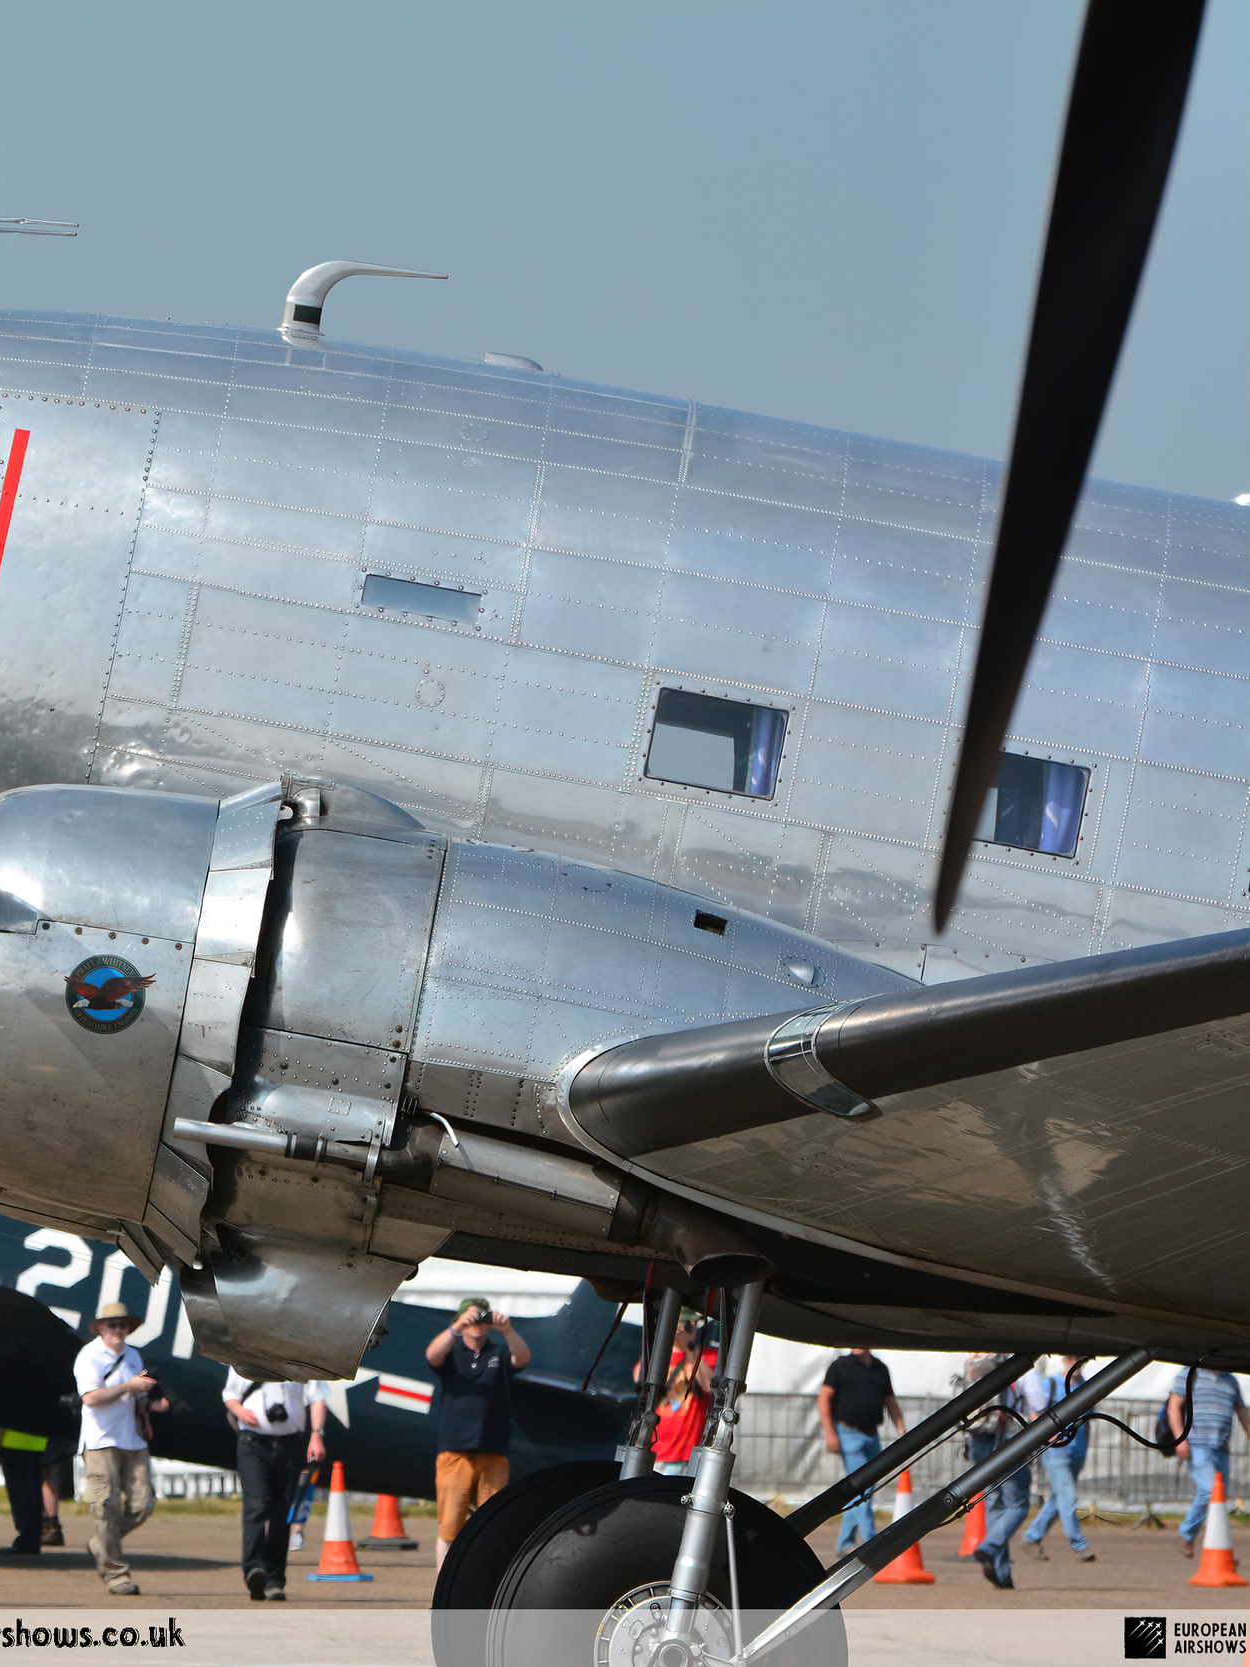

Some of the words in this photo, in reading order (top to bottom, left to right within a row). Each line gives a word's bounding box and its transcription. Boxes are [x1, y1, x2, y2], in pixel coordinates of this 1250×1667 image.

[102, 957, 136, 977] WHITNEY
[74, 1008, 112, 1030] DEPENDABLE
[113, 1008, 139, 1030] ENGINES
